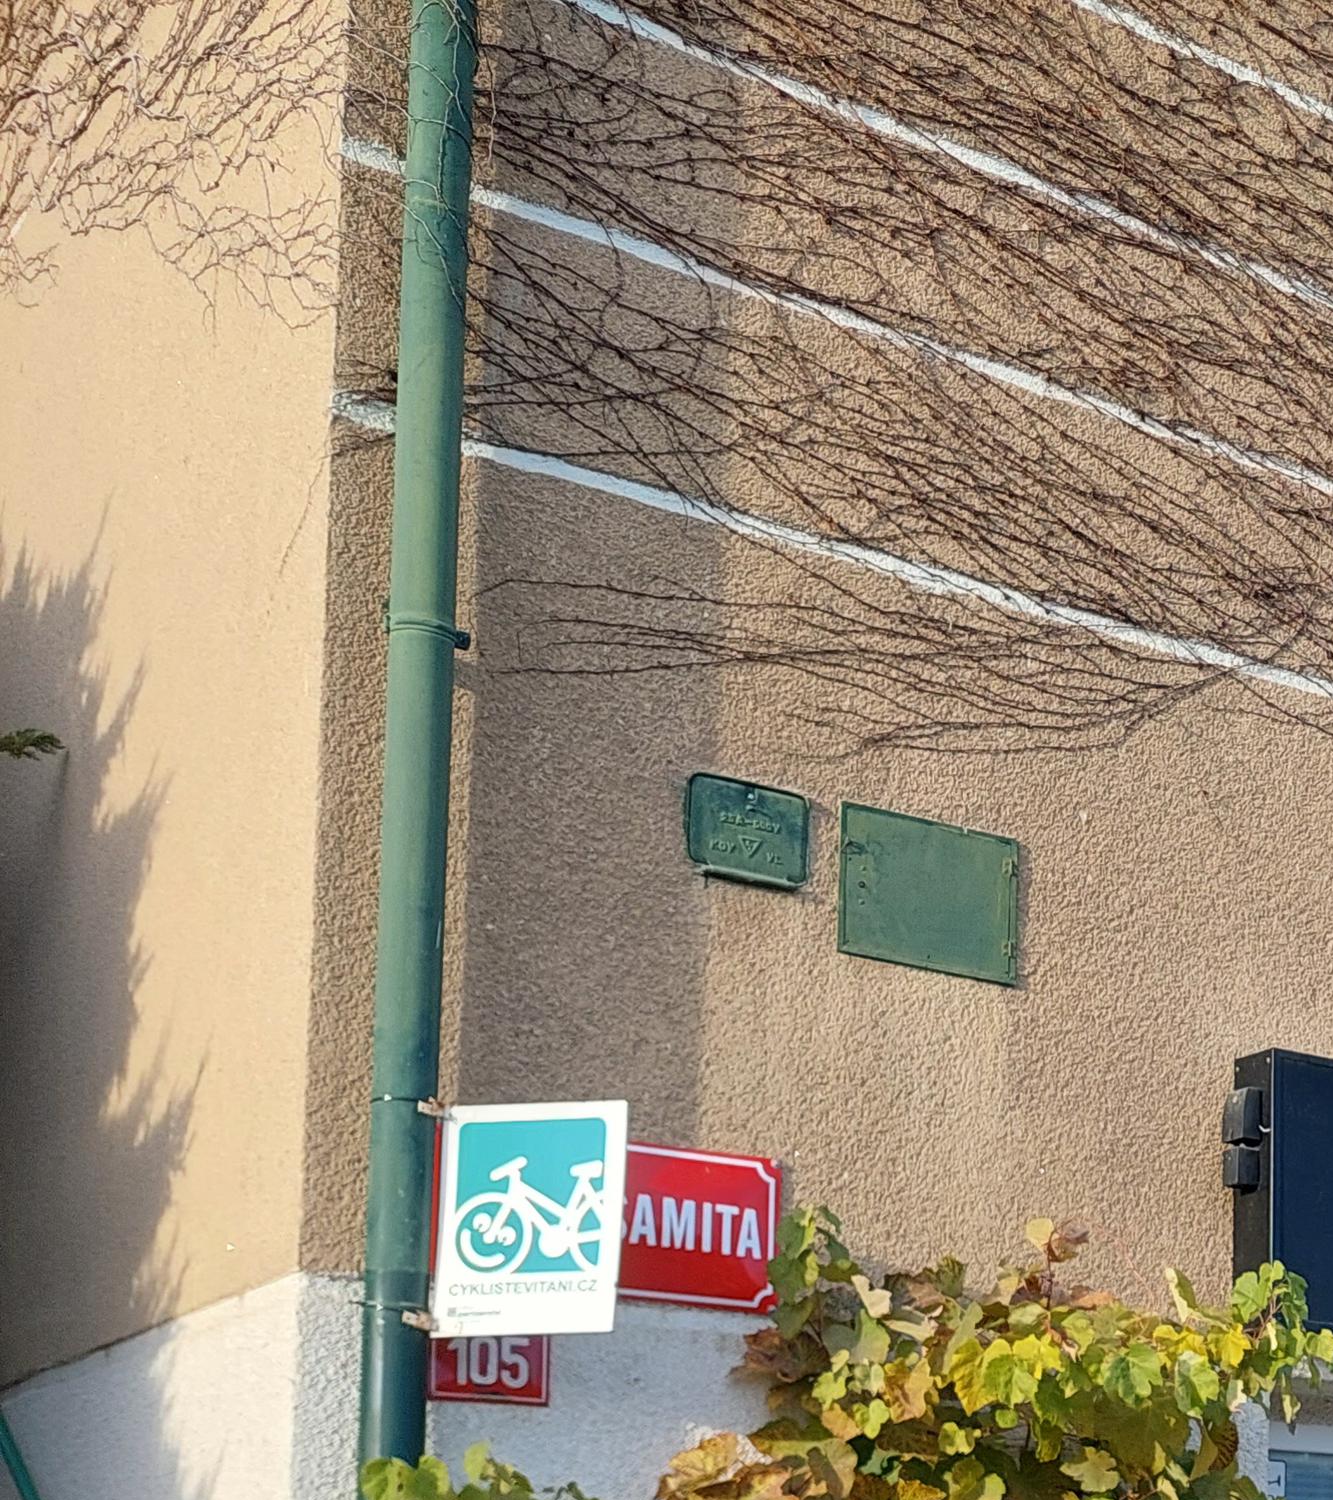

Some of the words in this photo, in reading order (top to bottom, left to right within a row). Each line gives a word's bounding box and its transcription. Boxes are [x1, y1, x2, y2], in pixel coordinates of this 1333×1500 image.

[621, 1194, 762, 1260] AMITA
[448, 1279, 598, 1297] CYKLISTEVITANI.CZ
[447, 1336, 530, 1389] 105
